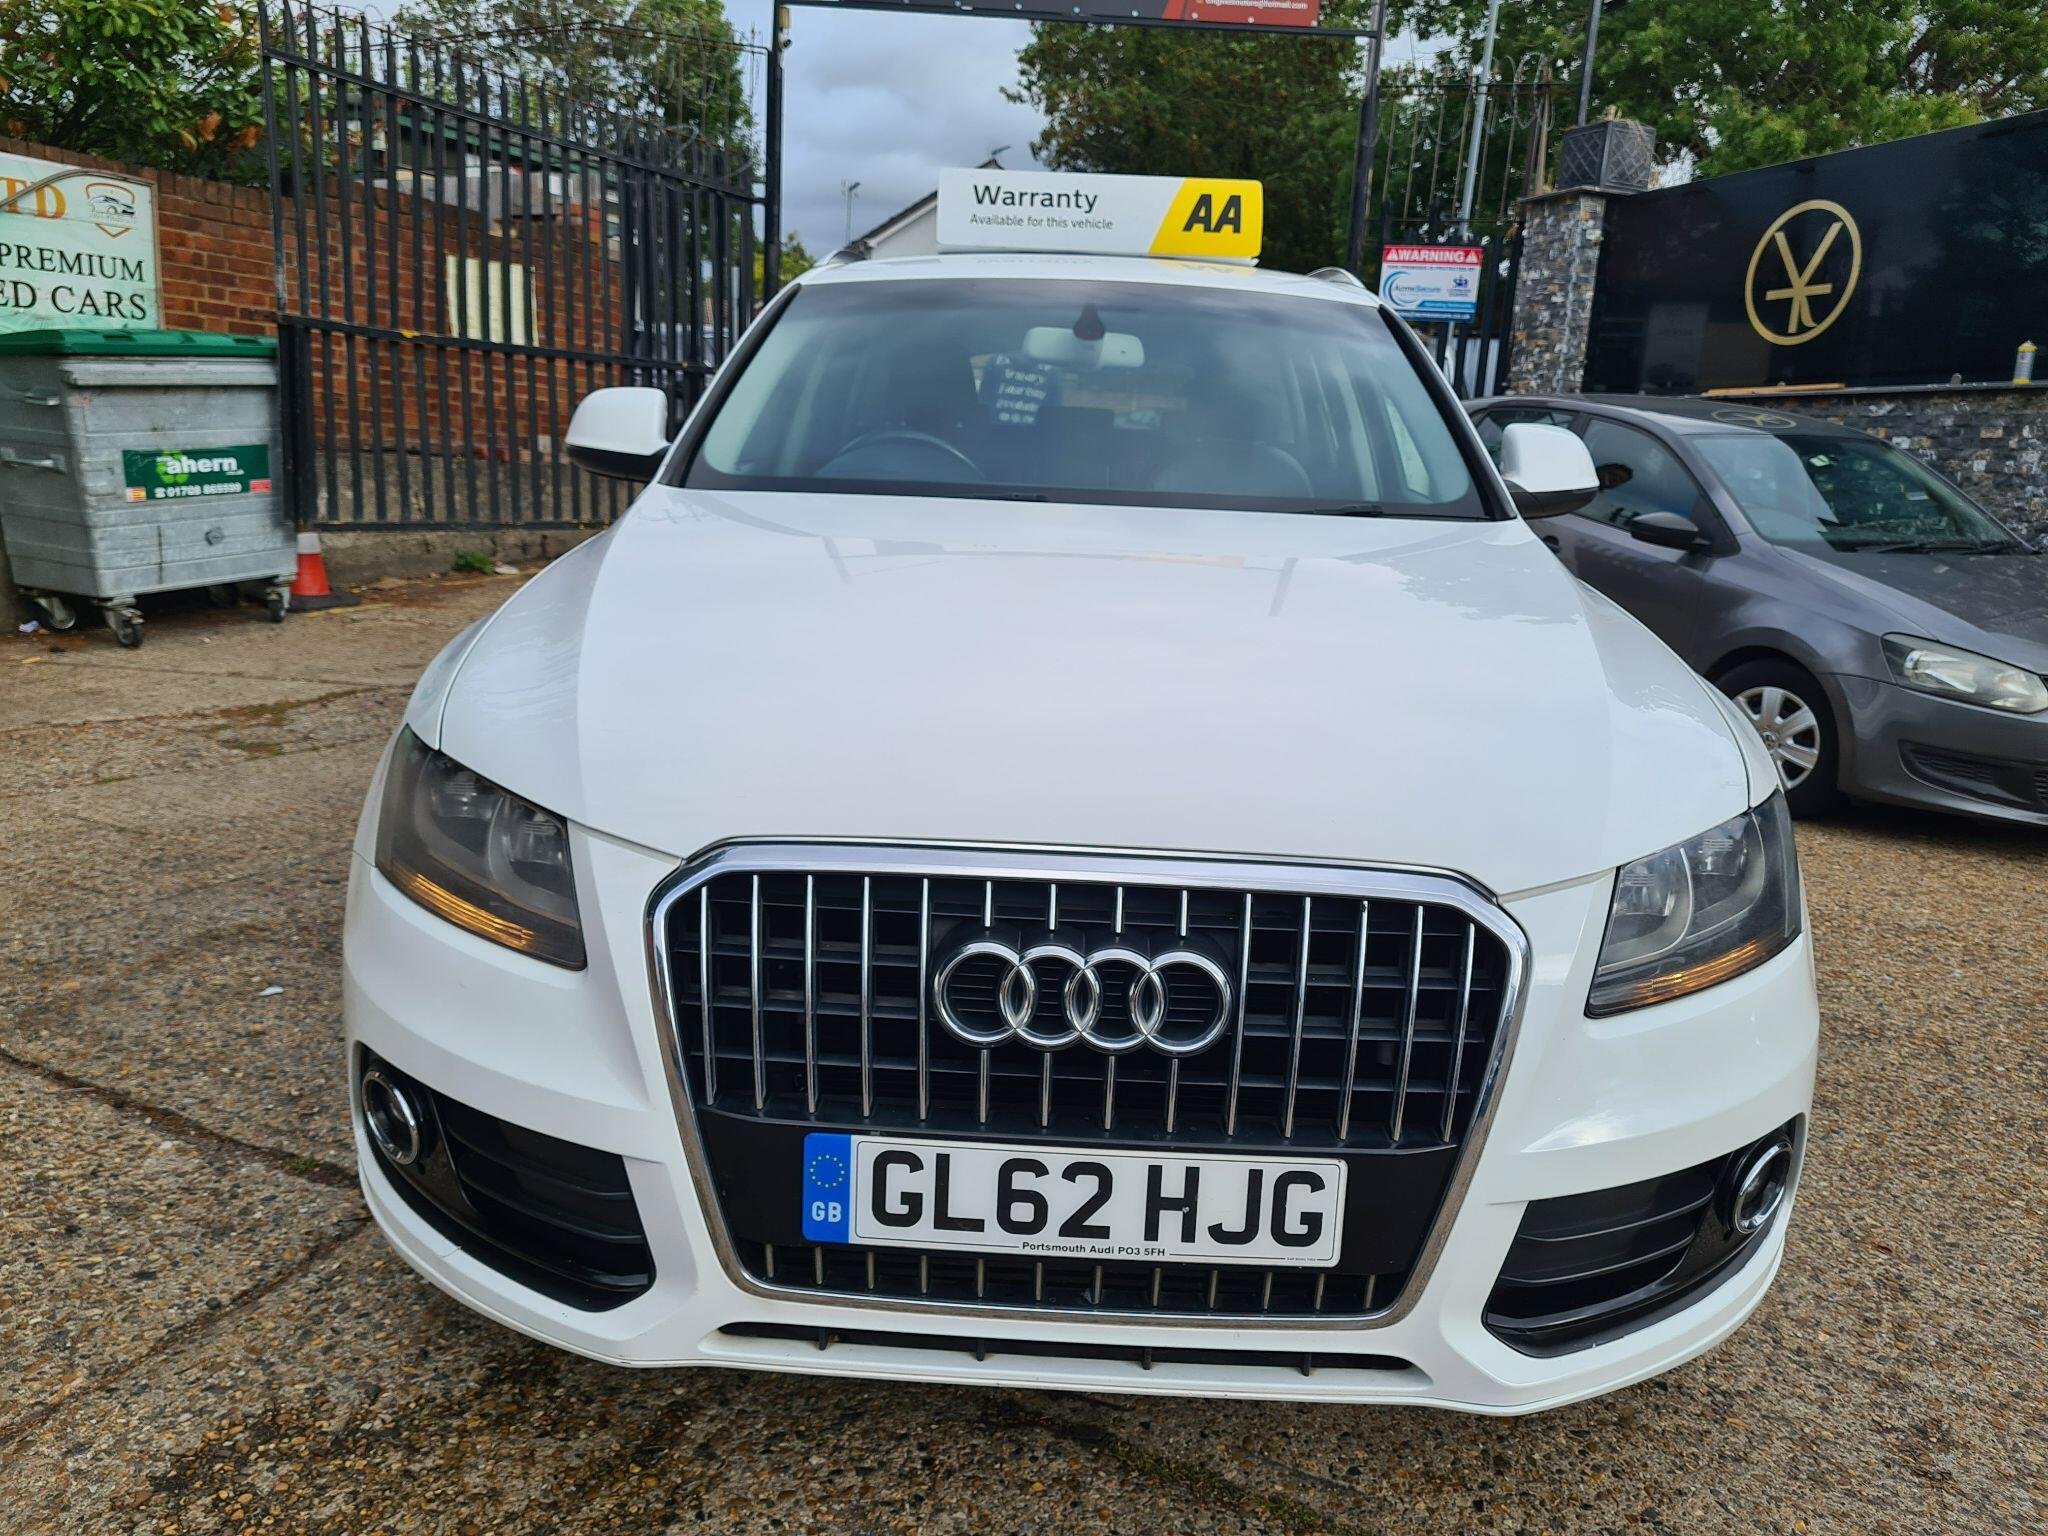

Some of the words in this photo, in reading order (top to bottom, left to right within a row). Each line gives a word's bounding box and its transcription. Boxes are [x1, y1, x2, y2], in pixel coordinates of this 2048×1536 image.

[974, 184, 1098, 213] Warranty
[969, 214, 1023, 226] Available
[1027, 216, 1043, 227] for
[1046, 217, 1068, 228] this
[1071, 219, 1113, 230] vehicle
[1183, 193, 1241, 233] AA
[0, 243, 145, 282] PREMIUM
[1398, 248, 1465, 263] WARNING
[51, 285, 147, 321] CARS
[166, 455, 238, 475] ahern
[811, 1200, 842, 1223] GB
[871, 1150, 1114, 1240] GL62
[1143, 1164, 1326, 1248] HJG
[1022, 1241, 1086, 1253] Portsmouth
[1089, 1245, 1114, 1254] Audi
[1118, 1246, 1140, 1255] PO3
[1144, 1248, 1165, 1256] 5FH
